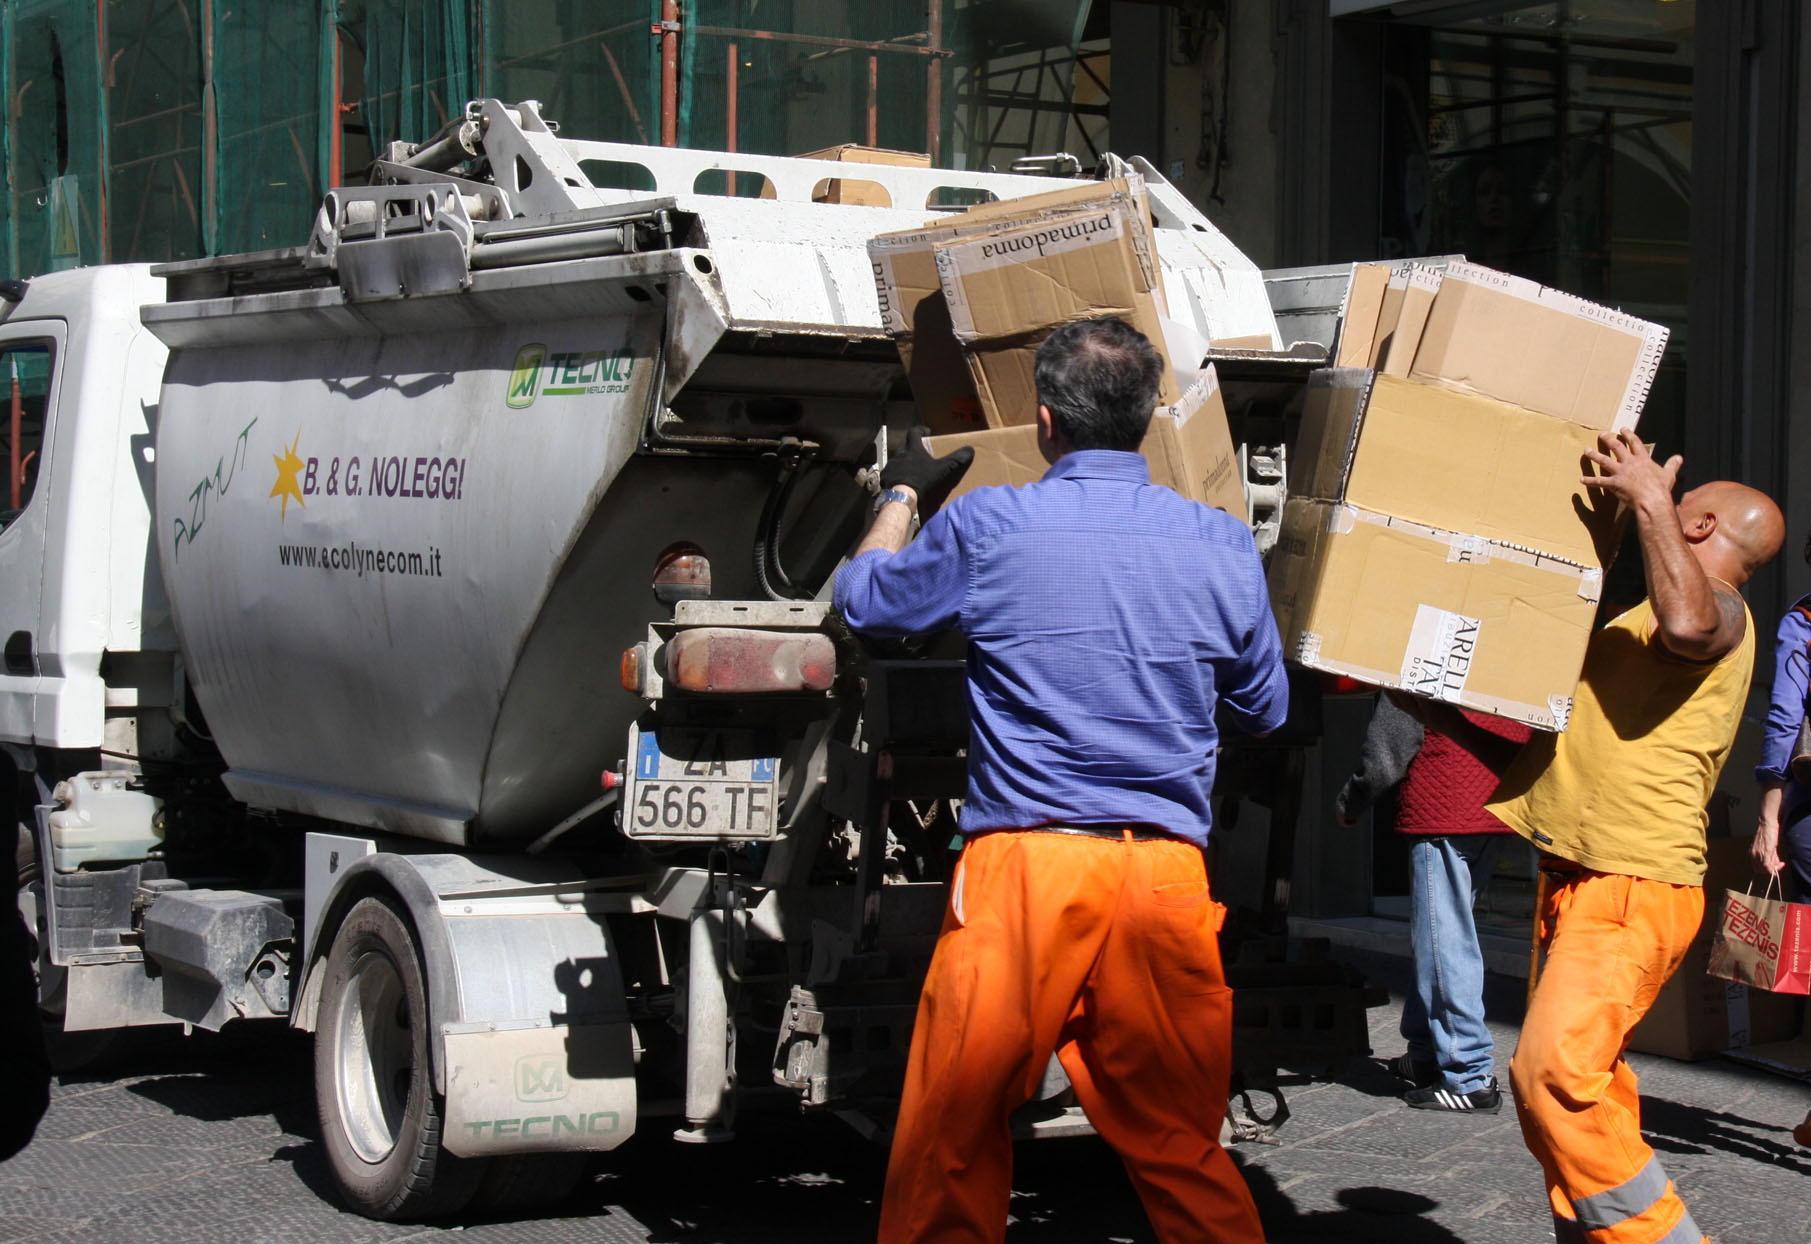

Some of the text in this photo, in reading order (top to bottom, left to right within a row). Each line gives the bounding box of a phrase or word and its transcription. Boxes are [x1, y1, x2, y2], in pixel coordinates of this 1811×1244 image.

[982, 213, 1113, 258] primadonna
[303, 457, 320, 496] B.
[326, 456, 340, 496] &
[345, 456, 363, 497] G.
[637, 784, 770, 830] 566 TF
[464, 1111, 619, 1140] TECNO
